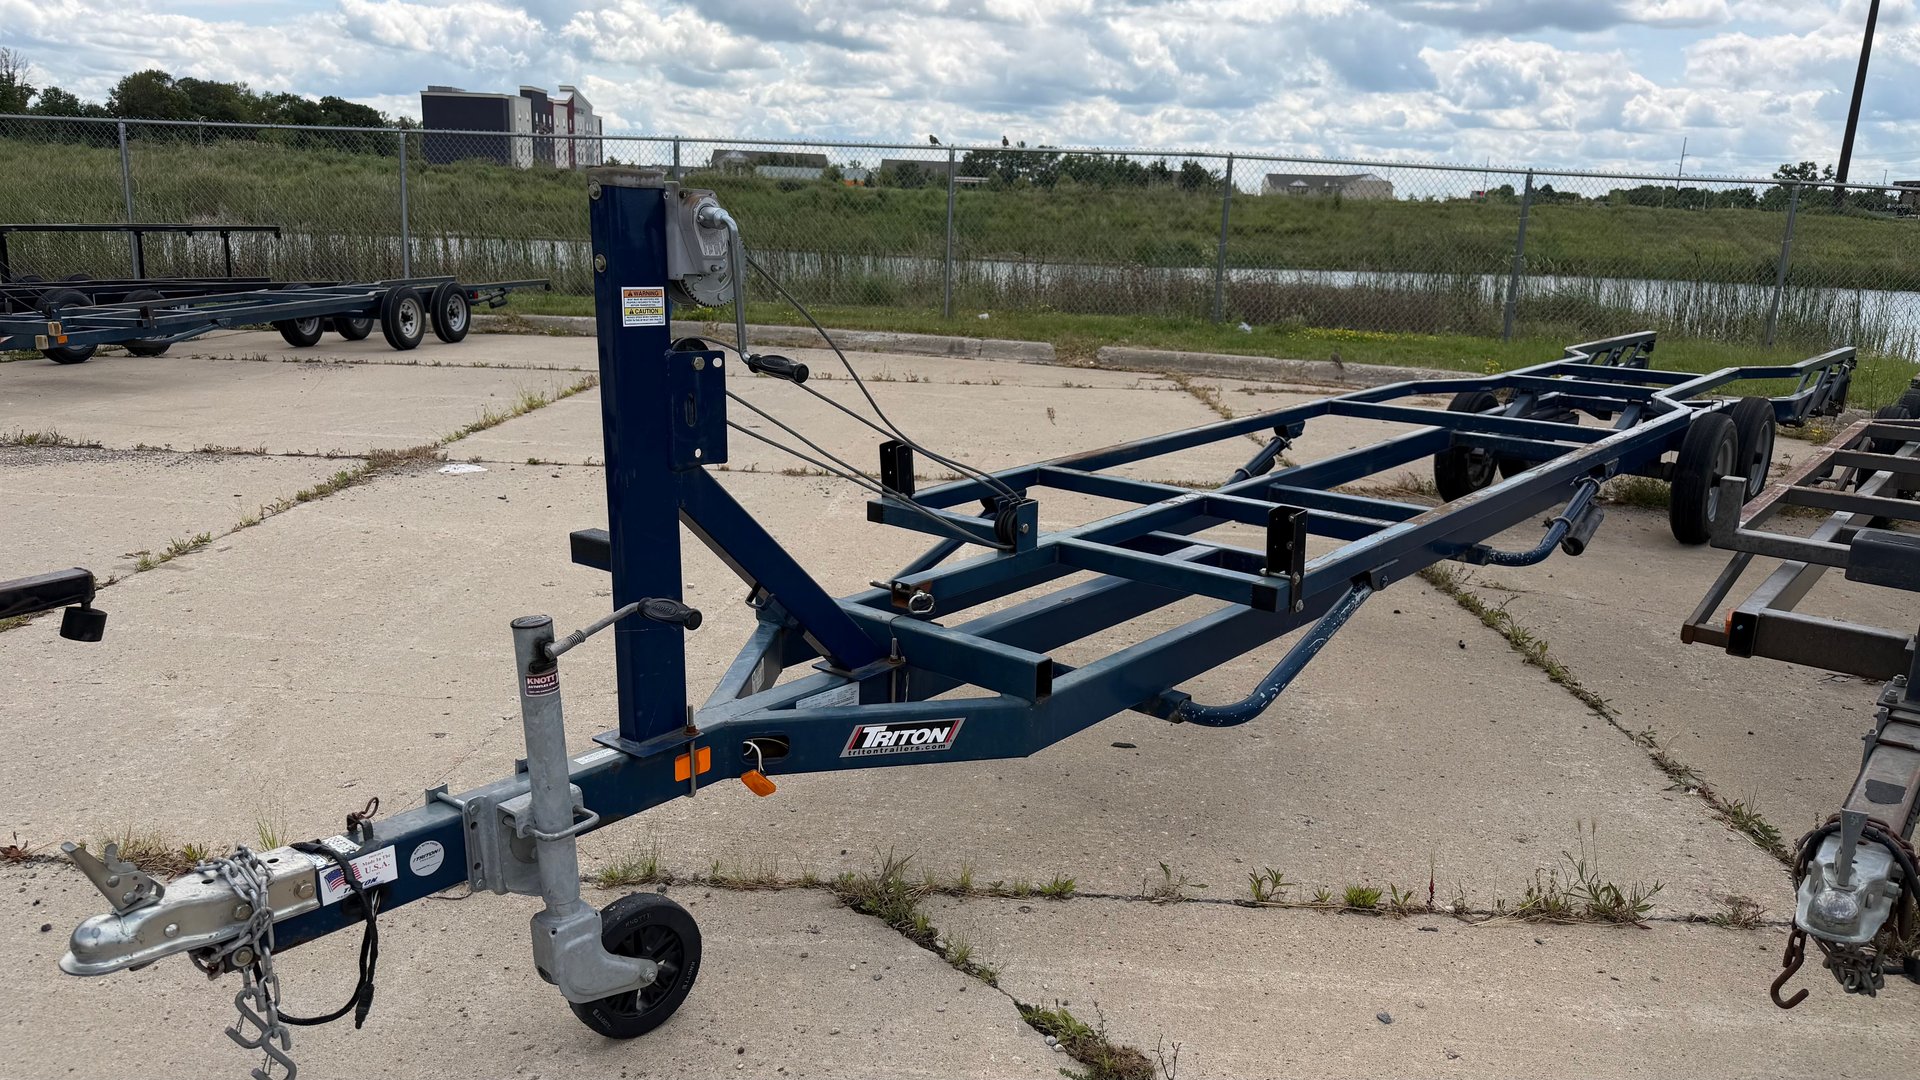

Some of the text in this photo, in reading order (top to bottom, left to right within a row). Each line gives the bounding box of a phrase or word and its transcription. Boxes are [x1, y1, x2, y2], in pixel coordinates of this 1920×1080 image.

[527, 673, 556, 685] KNOTT
[861, 725, 951, 749] TRITON
[848, 743, 946, 756] tritontrailers.com
[364, 861, 390, 874] U.S.A.
